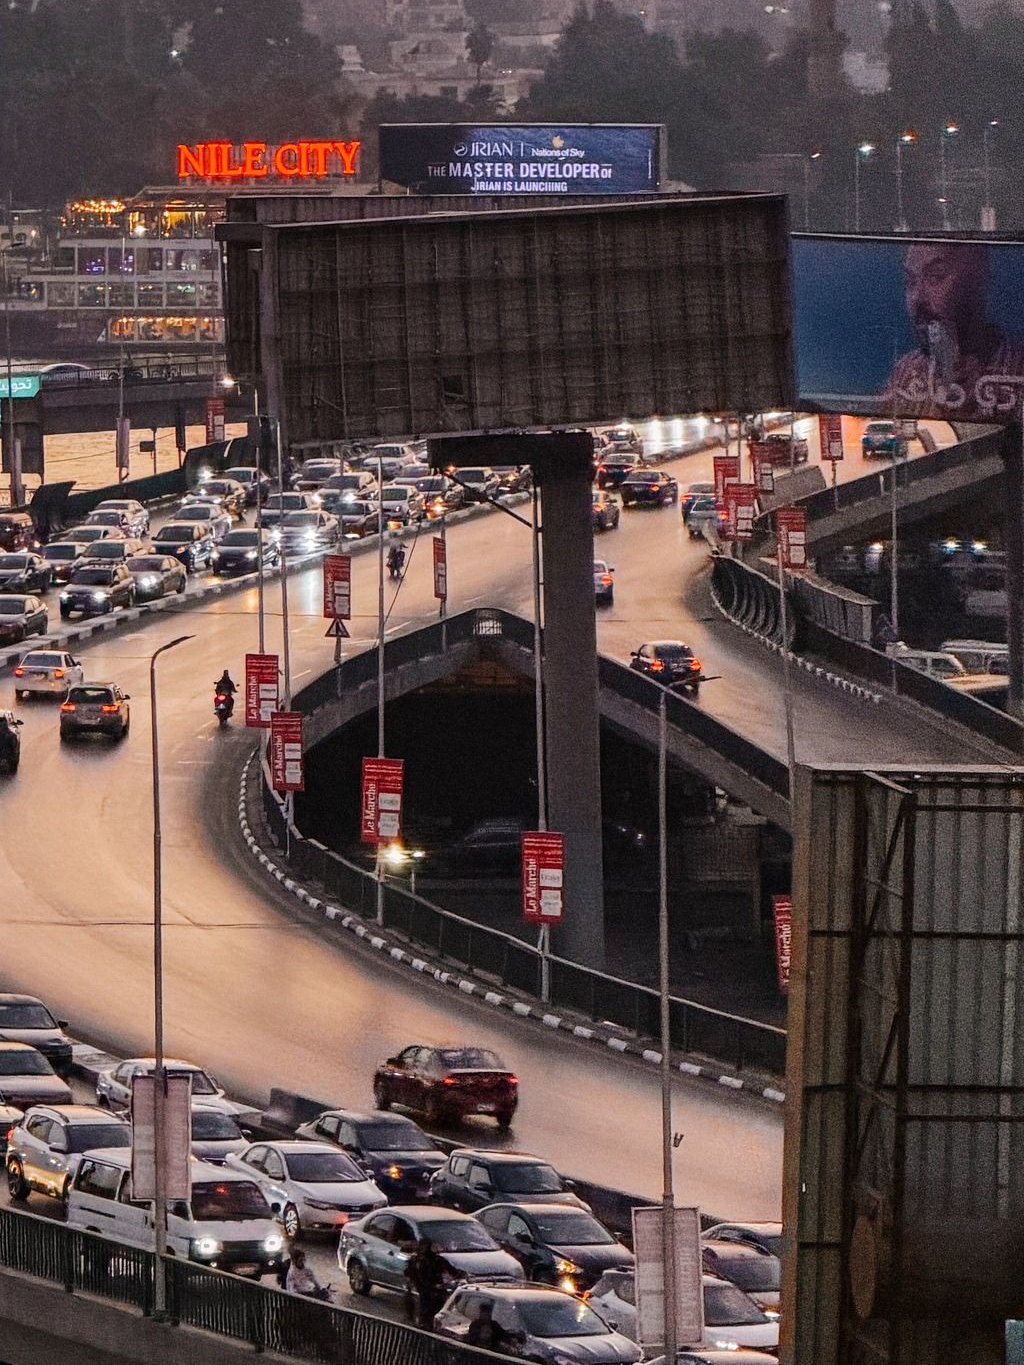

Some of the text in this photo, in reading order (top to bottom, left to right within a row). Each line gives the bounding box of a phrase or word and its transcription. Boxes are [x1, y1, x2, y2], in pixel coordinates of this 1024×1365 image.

[177, 140, 361, 177] NILE CITY
[531, 147, 561, 157] Nations
[569, 148, 586, 159] Sky
[427, 165, 446, 177] THE
[448, 162, 514, 178] MASTER
[519, 162, 600, 179] DEVELOPER
[503, 181, 513, 192] IS
[514, 181, 568, 193] LAUNCHING
